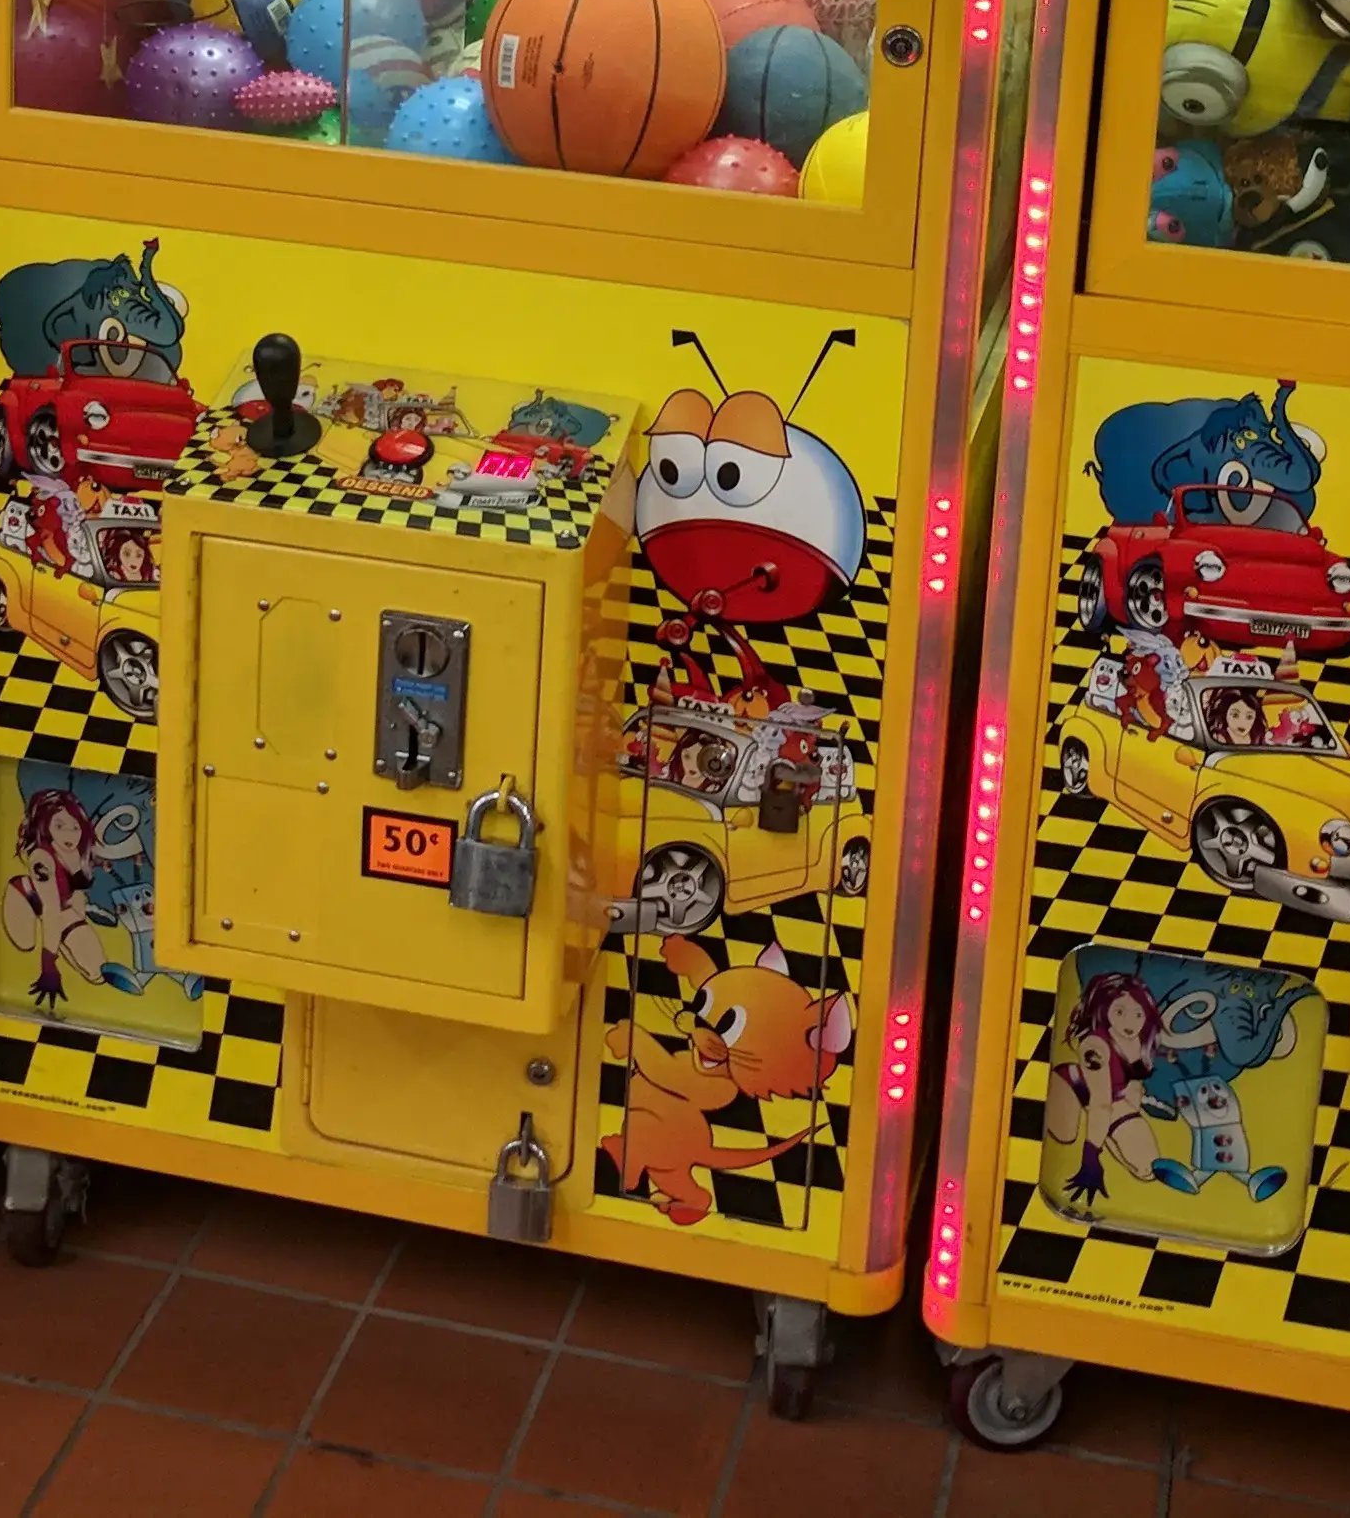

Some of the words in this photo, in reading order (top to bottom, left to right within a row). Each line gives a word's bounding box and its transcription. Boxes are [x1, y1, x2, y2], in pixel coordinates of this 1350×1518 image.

[341, 477, 430, 499] DESCEND
[112, 503, 150, 517] TAXI
[1222, 661, 1265, 676] TAXI
[383, 824, 439, 856] 50¢
